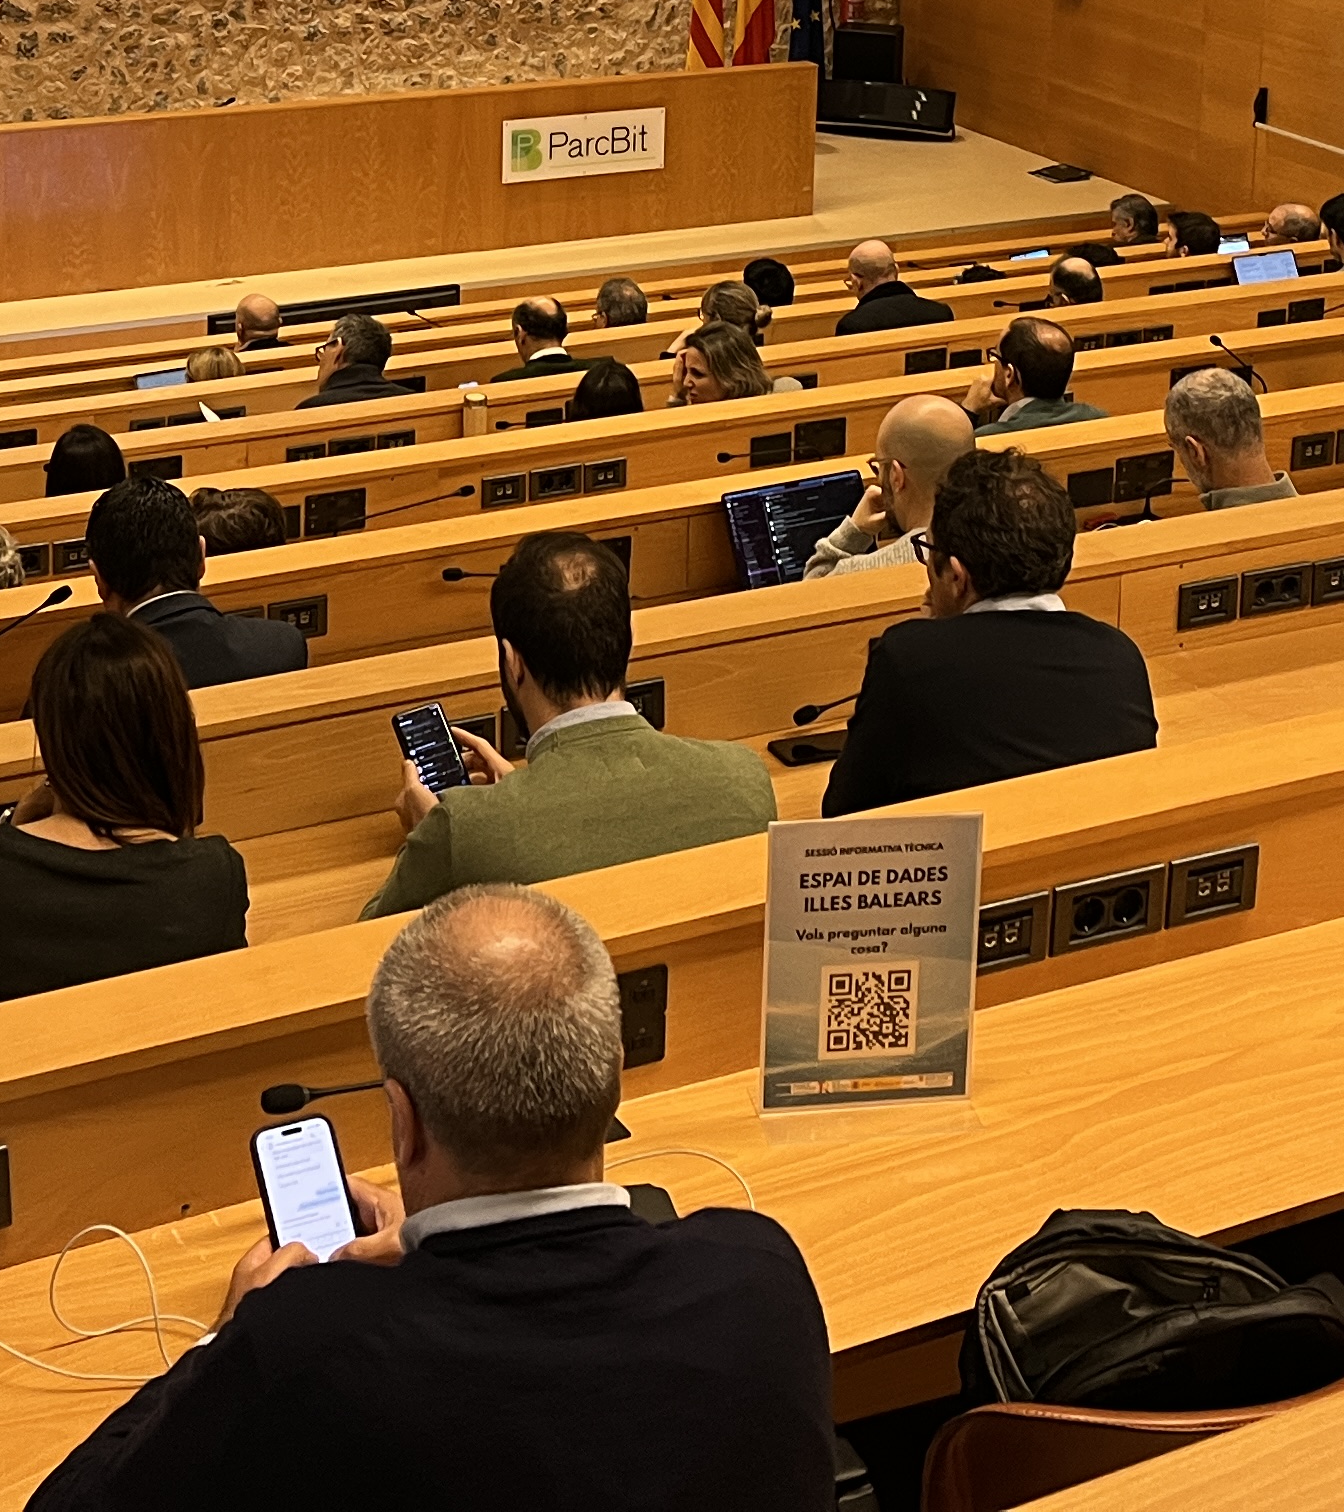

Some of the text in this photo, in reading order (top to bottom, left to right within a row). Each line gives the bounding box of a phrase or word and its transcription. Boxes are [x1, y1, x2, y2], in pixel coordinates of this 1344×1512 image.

[548, 124, 648, 161] ParcBit
[805, 846, 837, 858] SESSIÓ
[839, 843, 903, 856] INFORMATIVA
[799, 866, 948, 889] ESPAI DE DADES
[804, 890, 942, 913] ILLES BALEARS
[795, 922, 947, 942] Vols preguntar alguna
[850, 941, 888, 955] cosa?
